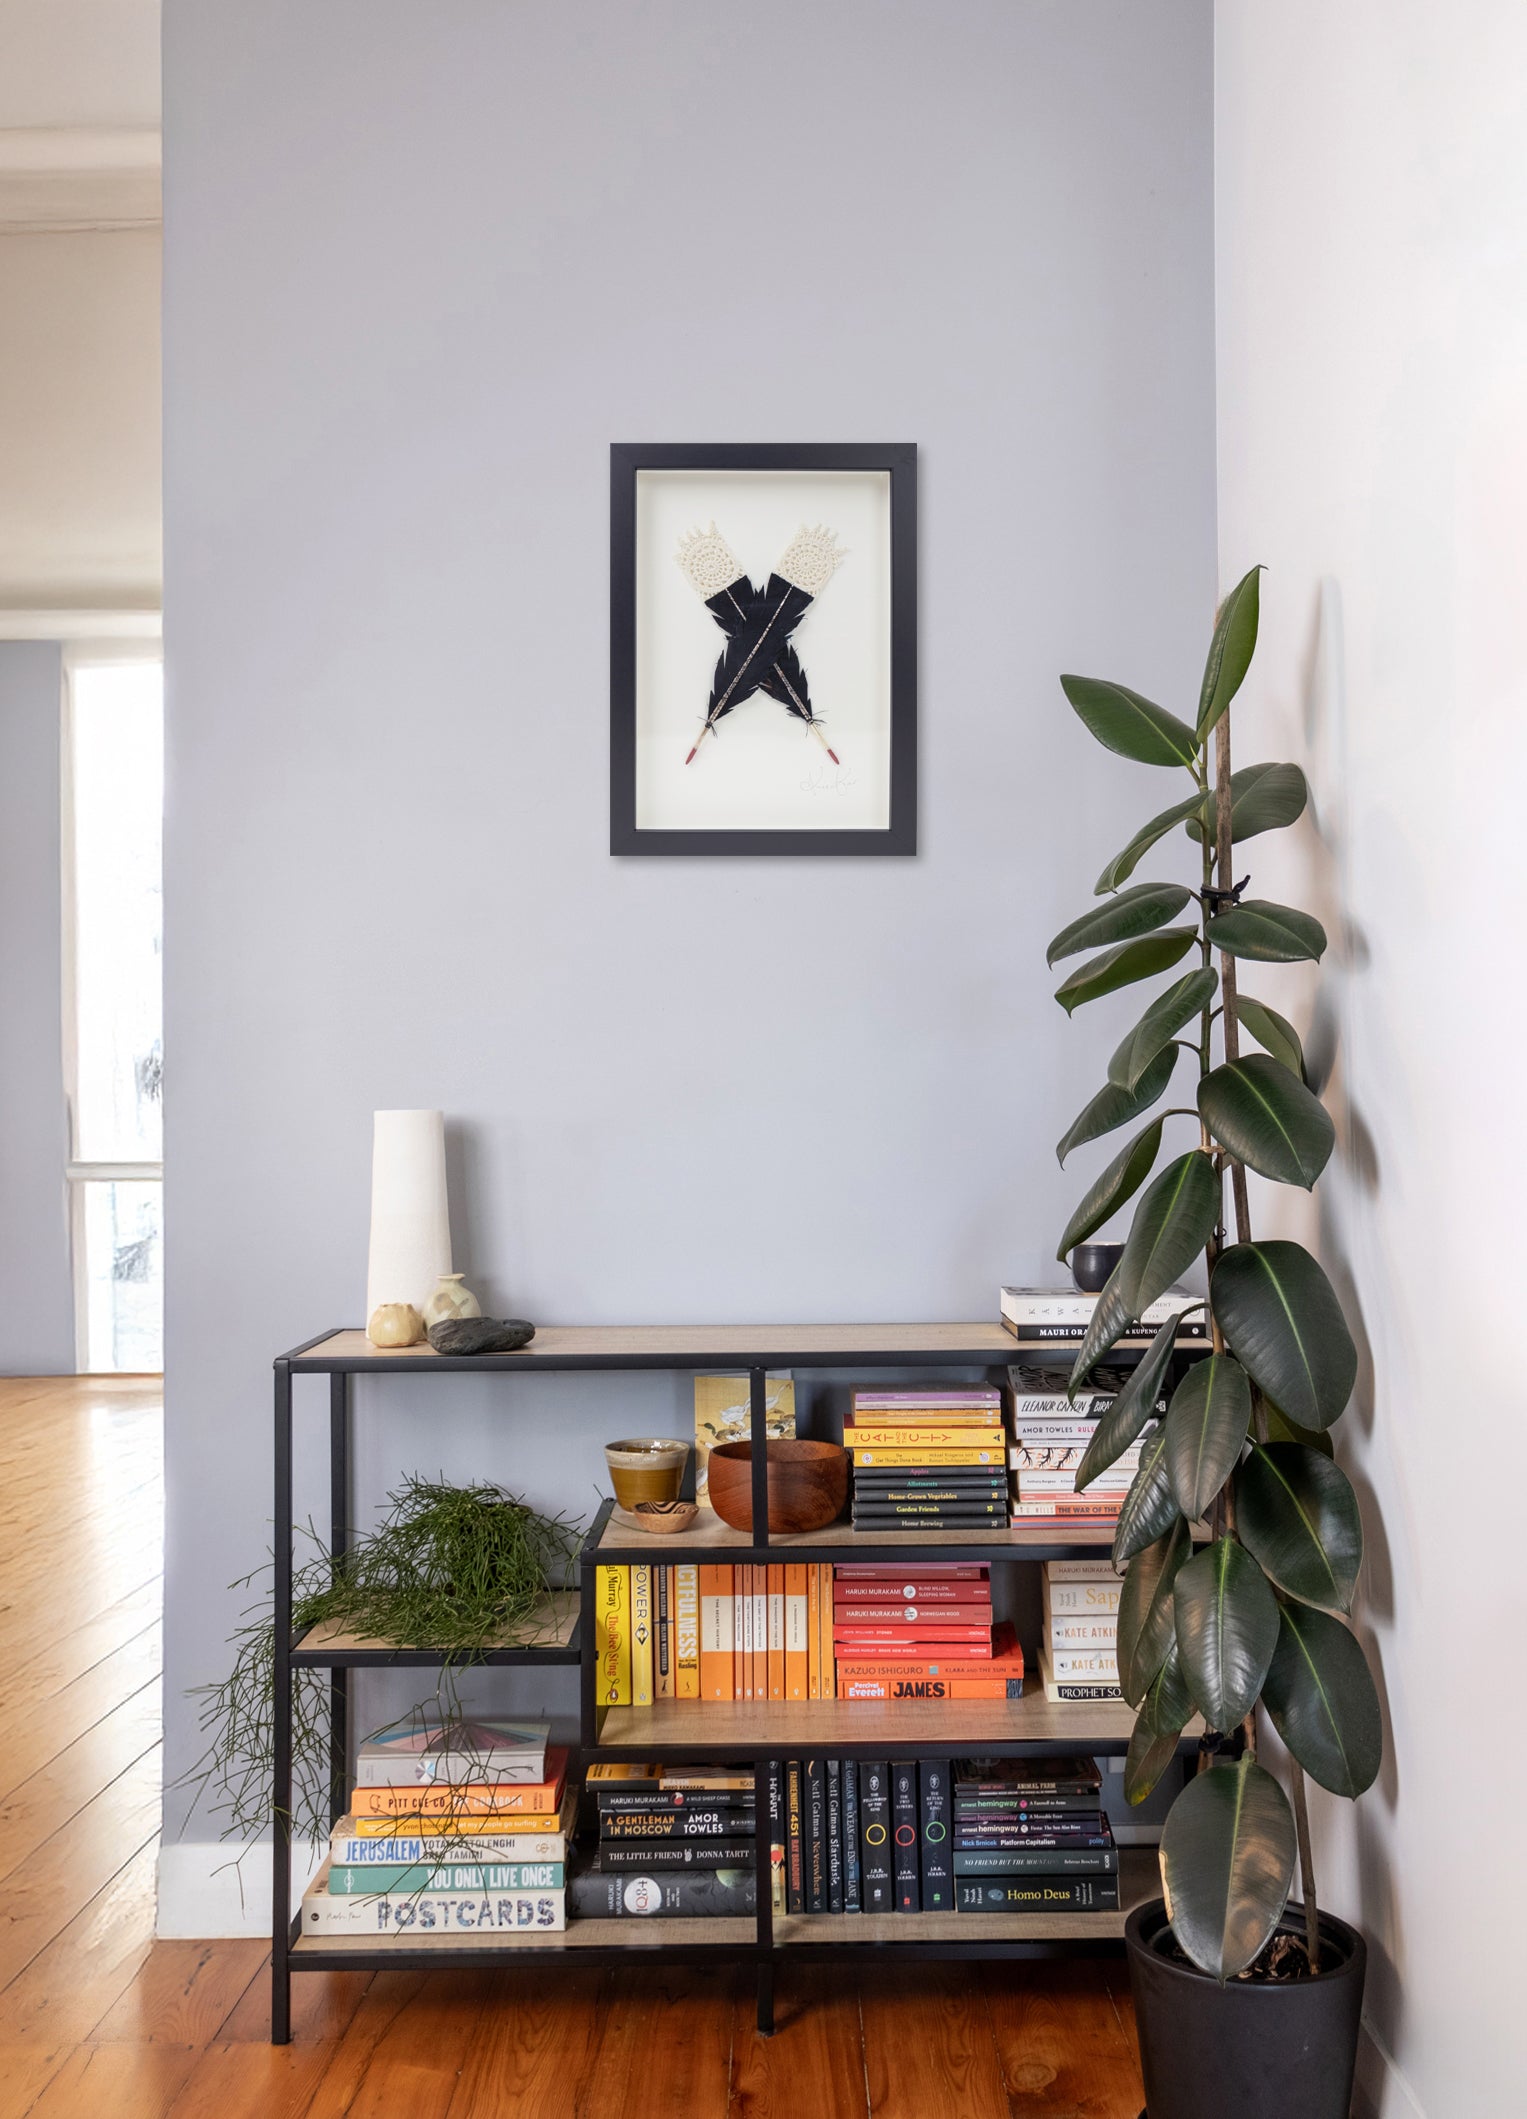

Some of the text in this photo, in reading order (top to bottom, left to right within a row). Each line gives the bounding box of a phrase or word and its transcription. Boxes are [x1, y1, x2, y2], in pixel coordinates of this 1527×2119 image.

[1039, 1328, 1069, 1337] MAURI
[1021, 1400, 1056, 1413] ELEANOR
[1022, 1426, 1043, 1434] AMOR
[896, 1505, 917, 1513] Garden
[1058, 1505, 1118, 1514] THE WAR OF THE
[920, 1520, 944, 1528] Brewing
[606, 1576, 618, 1607] Murray
[1064, 1627, 1118, 1638] KATE ATKI
[606, 1616, 619, 1677] The Bee Sting
[1071, 1659, 1095, 1670] KATE
[878, 1667, 924, 1675] ISHIGURO
[848, 1682, 945, 1698] Everett JAMES
[1061, 1687, 1122, 1698] PROPHET SO
[829, 1777, 839, 1798] Neil
[845, 1770, 854, 1800] GAIMAN
[388, 1798, 408, 1808] PITT
[412, 1798, 429, 1808] CUE
[473, 1795, 523, 1807] COOKBOOK
[610, 1797, 634, 1805] HARUKI
[634, 1796, 669, 1804] MURAKAMI
[977, 1800, 1018, 1808] hemingway
[607, 1815, 675, 1825] A GENTLEMAN
[688, 1813, 719, 1823] AMOR
[829, 1799, 839, 1836] Gaiman
[846, 1810, 856, 1835] OCEAN
[977, 1814, 1018, 1822] hemingway
[514, 1820, 537, 1828] surfing
[683, 1824, 724, 1834] TOWLES
[978, 1825, 1019, 1833] hemingway
[610, 1825, 673, 1835] IN MOSCOW
[789, 1770, 800, 1891] FAHRENHEIT 451 RAY BRADBURY
[812, 1779, 822, 1896] Neil Gaiman Neverwhere
[345, 1840, 421, 1862] JERUSALEM
[609, 1850, 750, 1861] THE LITTLE FRIEND DONNA TARTT
[847, 1850, 855, 1864] END
[426, 1866, 554, 1889] YOU ONLY LIVE ONCE
[847, 1879, 857, 1898] LANE
[1007, 1889, 1071, 1900] Homo Deus
[377, 1898, 555, 1929] POSTCARDS
